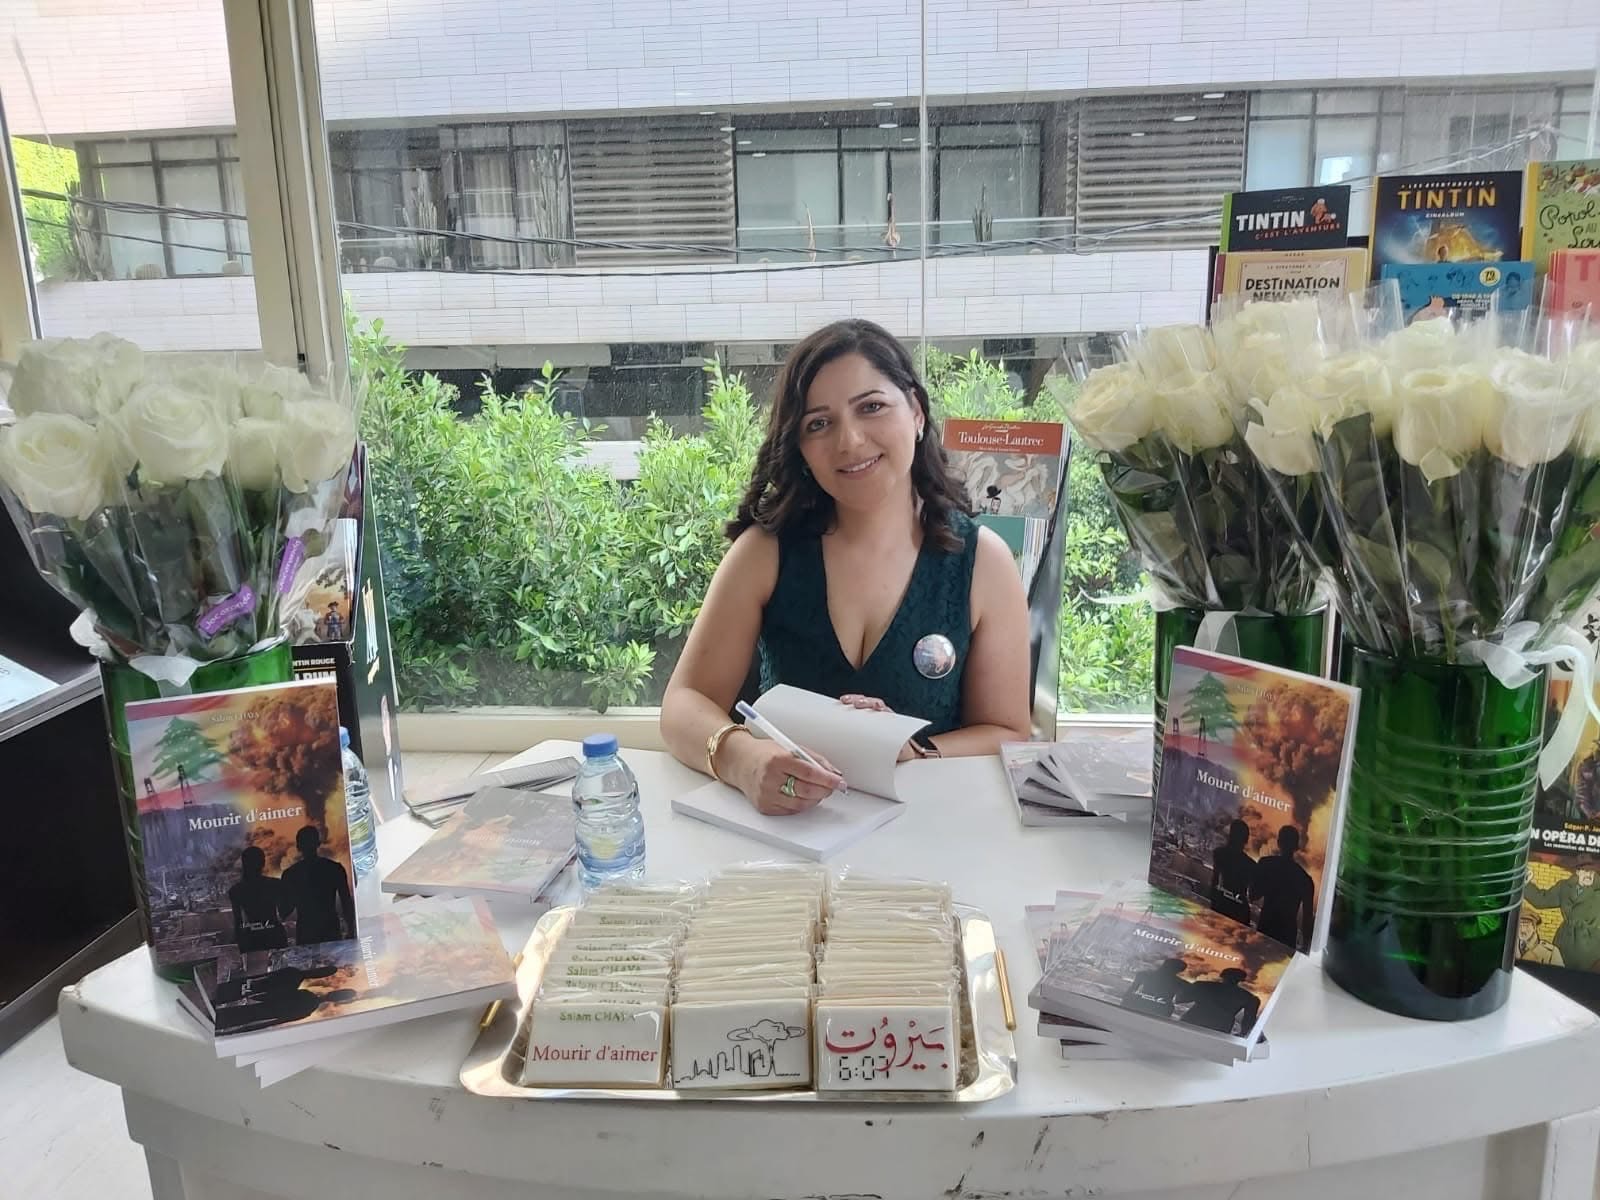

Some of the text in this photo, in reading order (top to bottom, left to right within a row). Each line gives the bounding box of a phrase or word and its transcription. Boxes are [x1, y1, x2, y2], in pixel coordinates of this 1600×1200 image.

[1397, 187, 1496, 210] TINTIN
[1236, 210, 1305, 232] TINTIN
[1245, 276, 1340, 291] DESTINATION
[958, 431, 1044, 446] Toulouse-Lautrec
[1196, 769, 1291, 812] Mourir d'aimer
[188, 806, 303, 832] Mourir d'aimer
[1542, 829, 1586, 845] OPÉRA
[1133, 928, 1240, 962] Mourir d'aimer
[560, 1011, 592, 1022] Salam
[532, 1044, 658, 1062] Mourir d'aimer
